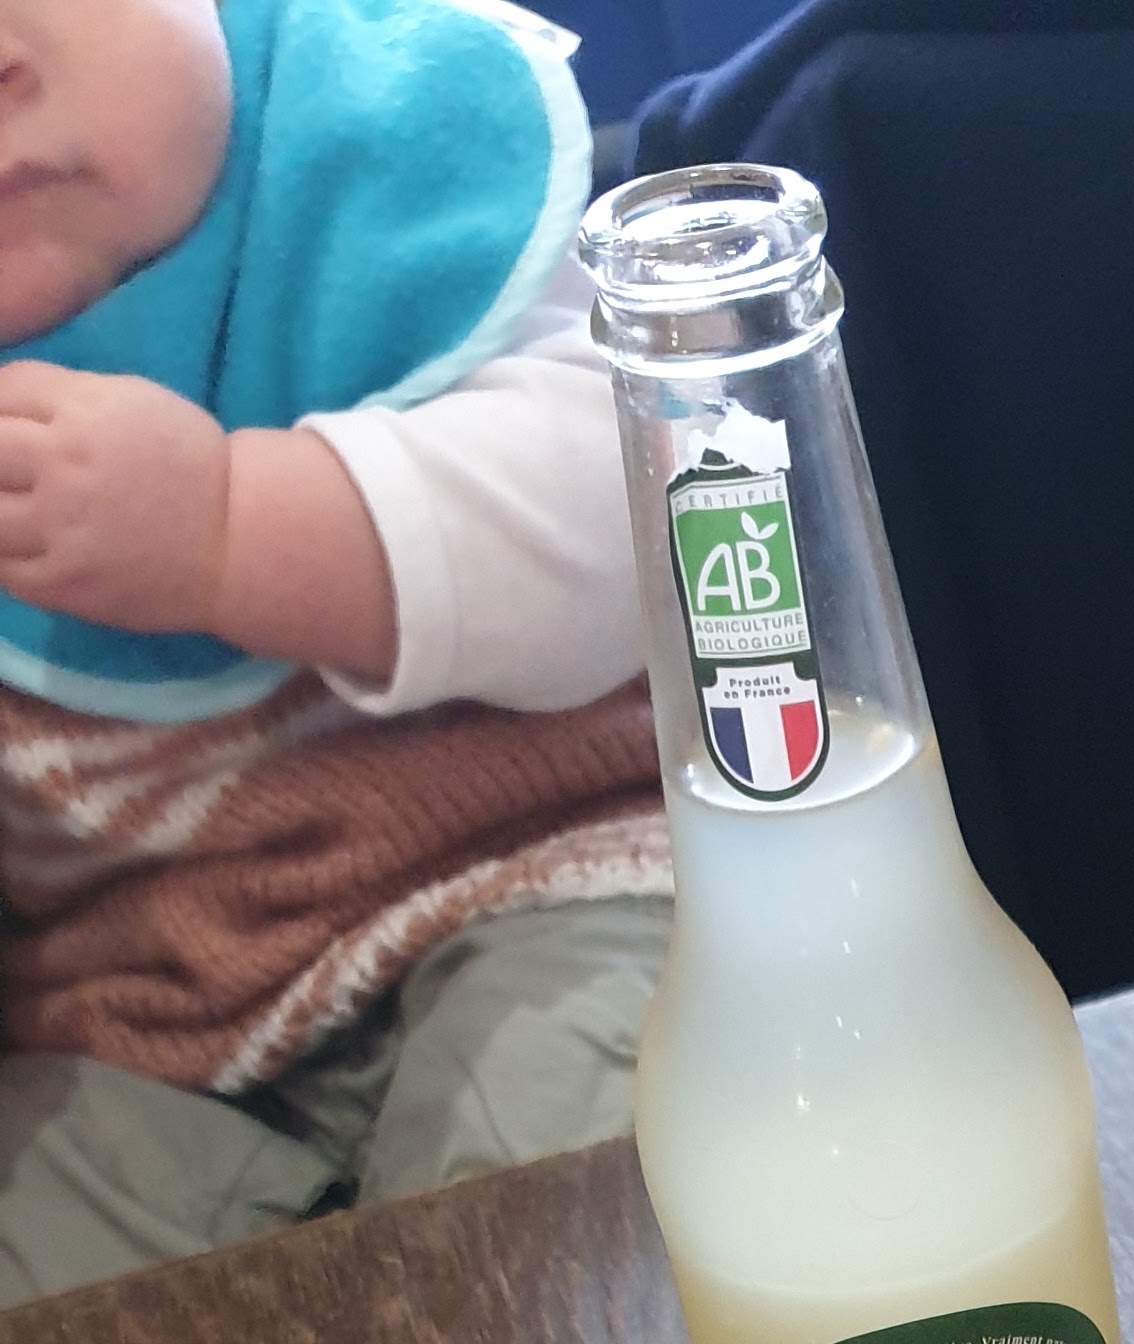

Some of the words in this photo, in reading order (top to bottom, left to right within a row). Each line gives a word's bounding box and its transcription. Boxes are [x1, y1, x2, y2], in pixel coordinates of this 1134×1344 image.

[675, 484, 784, 514] CERTIFIÉ
[697, 541, 780, 611] AB
[696, 613, 804, 633] AGRICULTURE
[698, 630, 806, 650] BIOLOGIQUE
[729, 676, 780, 687] Produit
[724, 691, 738, 699] en
[744, 686, 790, 698] France
